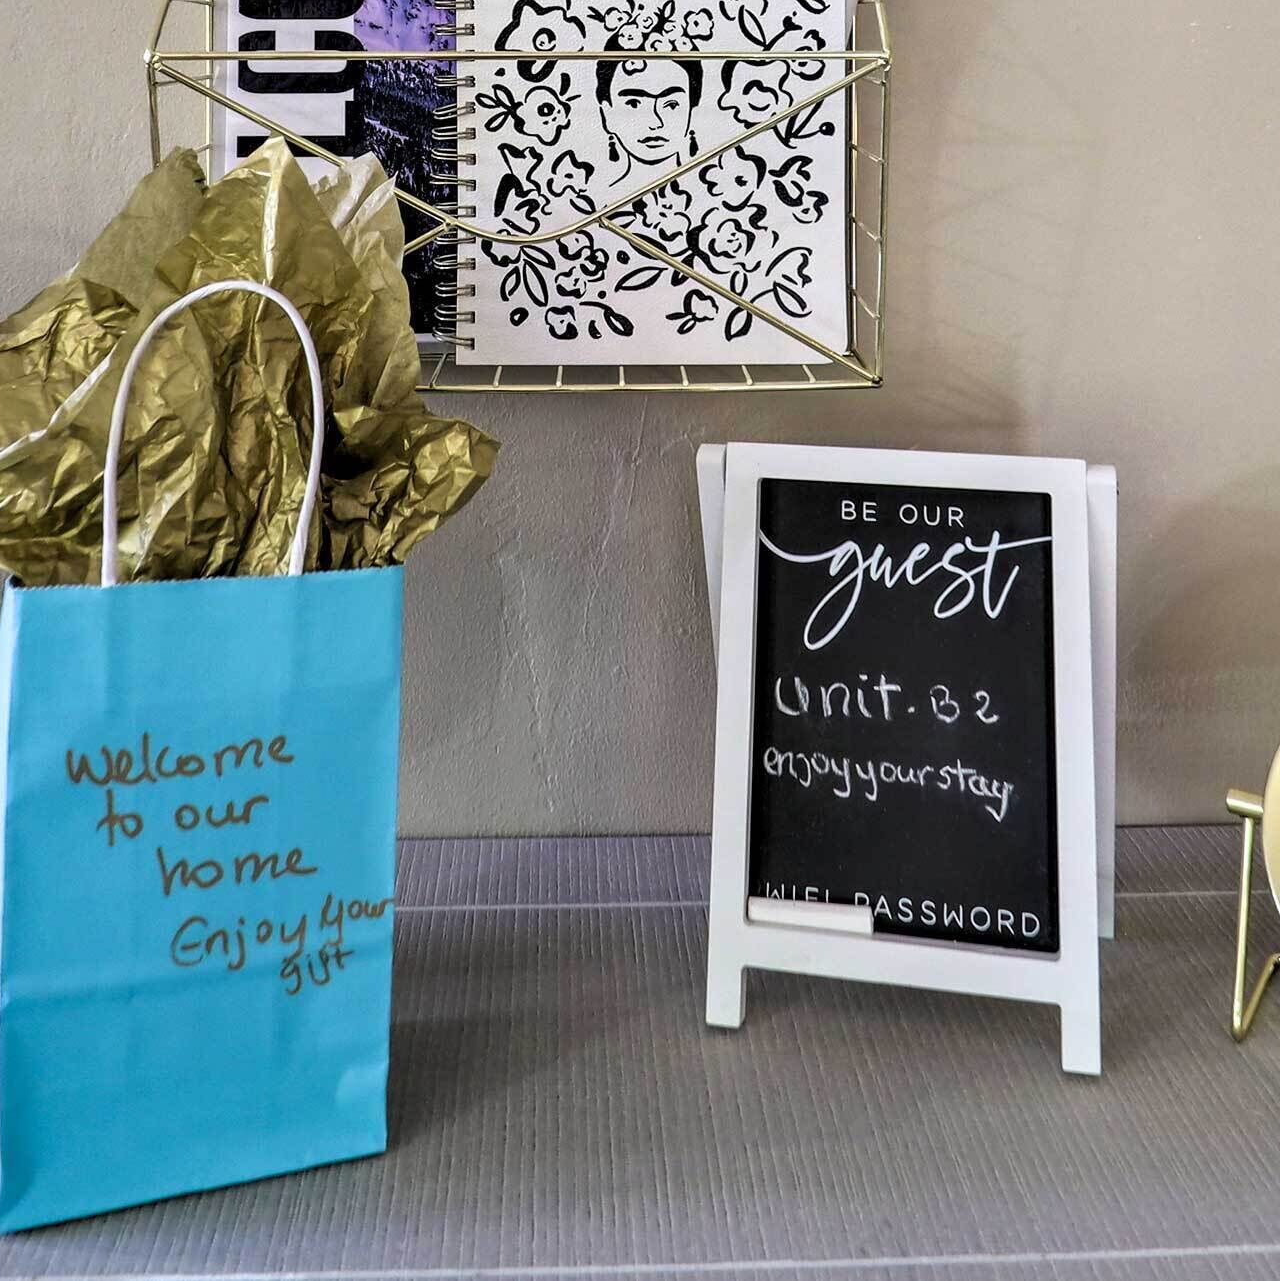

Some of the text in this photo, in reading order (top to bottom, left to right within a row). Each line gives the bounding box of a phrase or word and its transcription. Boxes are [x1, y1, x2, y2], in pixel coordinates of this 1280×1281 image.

[840, 499, 965, 528] BE OUR
[760, 530, 1052, 650] guest
[96, 788, 270, 847] to our
[156, 846, 319, 898] home
[854, 891, 1041, 938] PASSWORD
[171, 914, 307, 971] Enjoy
[280, 946, 354, 995] gift
